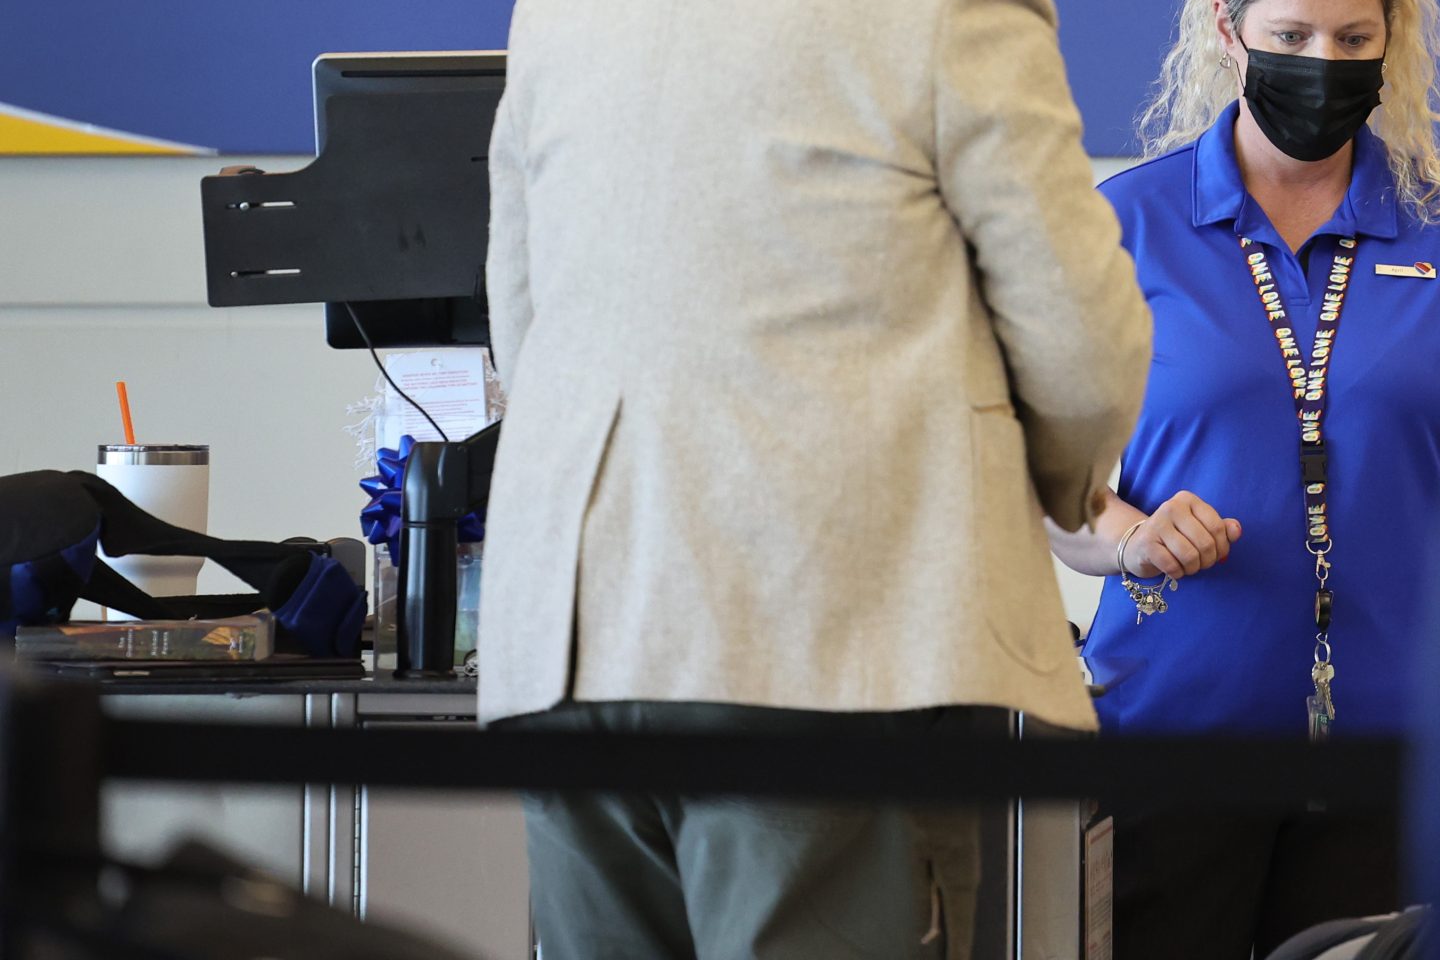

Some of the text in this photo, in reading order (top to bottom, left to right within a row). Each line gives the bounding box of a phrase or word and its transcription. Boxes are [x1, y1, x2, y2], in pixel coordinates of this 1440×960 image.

[1327, 255, 1354, 292] LOVE
[1319, 292, 1345, 321] ONE
[1247, 251, 1308, 400] ONE LOVE ONE LOVE
[1310, 329, 1336, 366] LOVE
[1304, 367, 1327, 401] ONE
[1301, 409, 1322, 445] OVE
[1307, 503, 1330, 543] LOVE
